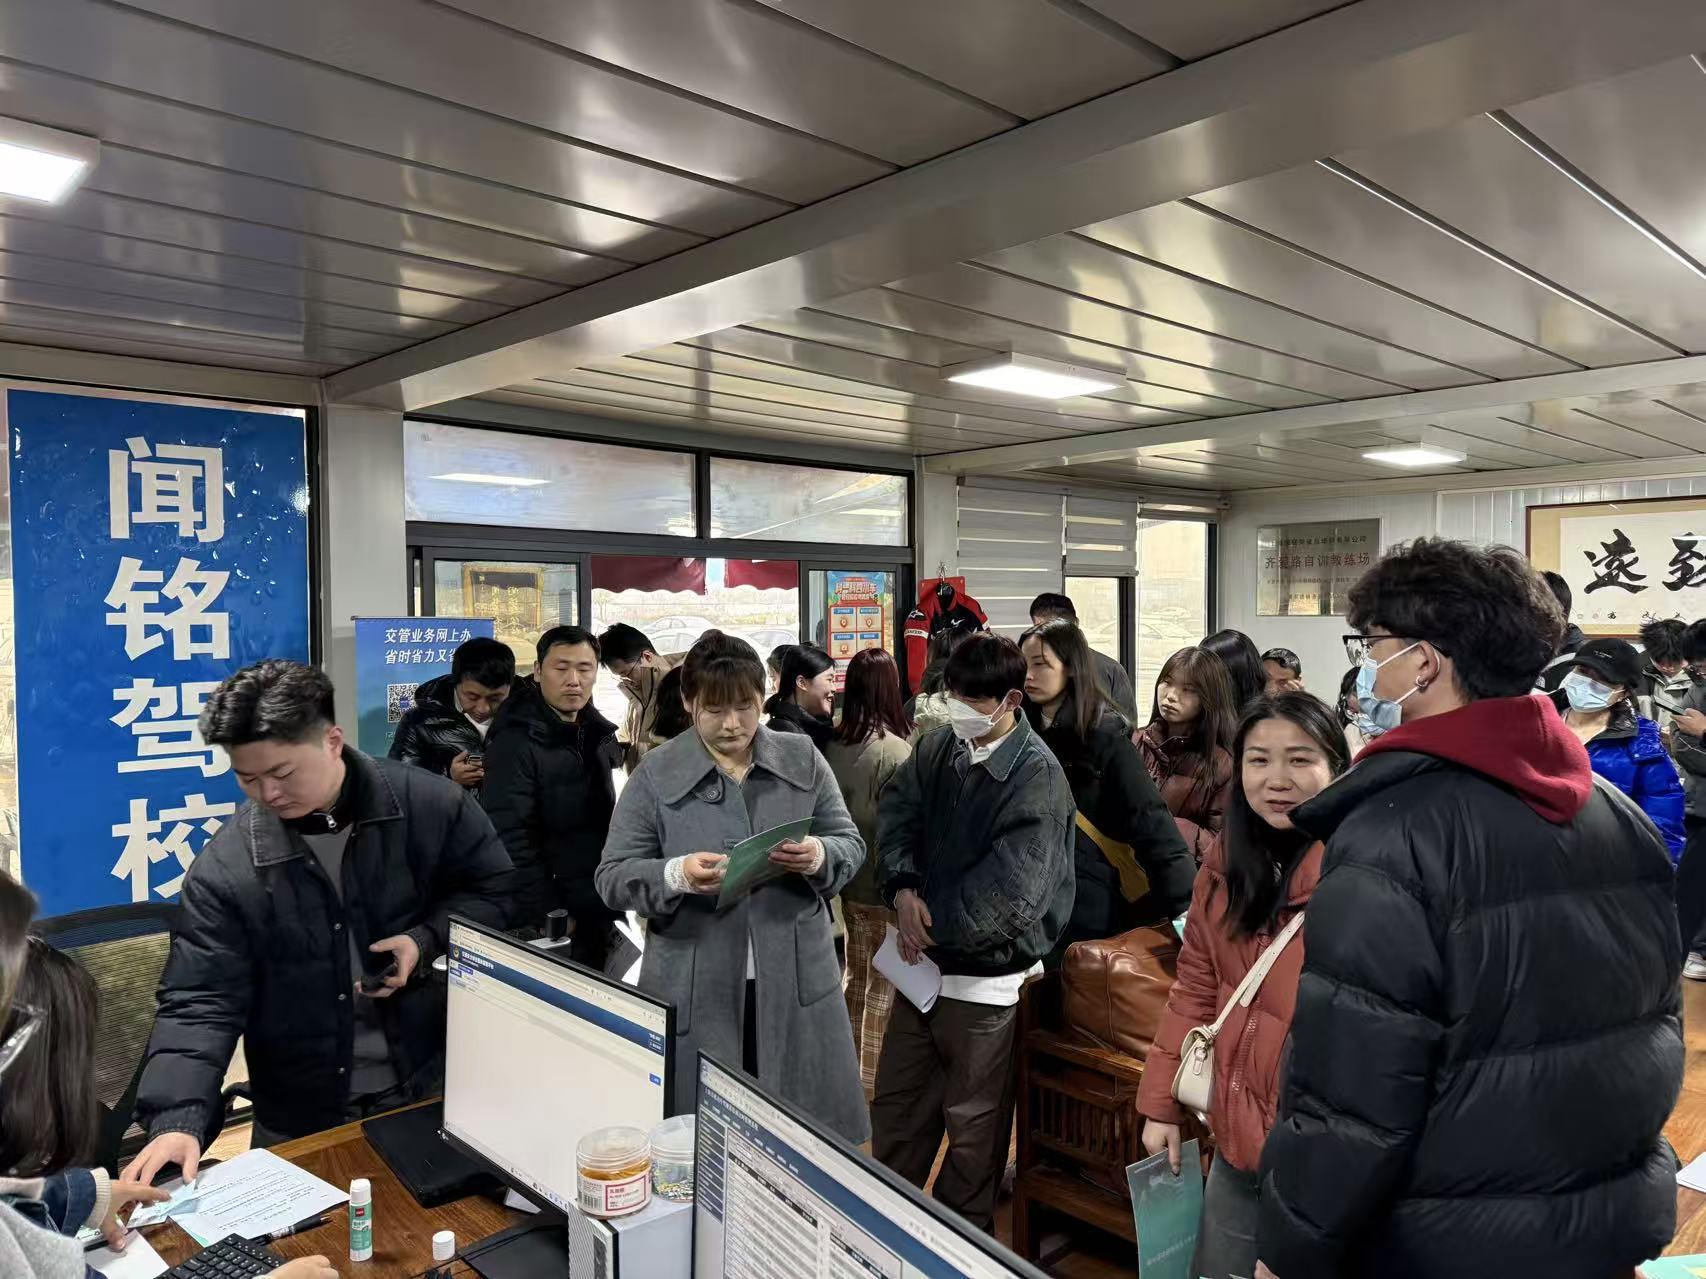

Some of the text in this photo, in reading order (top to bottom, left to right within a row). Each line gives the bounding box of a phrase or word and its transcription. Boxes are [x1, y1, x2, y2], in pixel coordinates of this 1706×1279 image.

[104, 436, 235, 903] 闻铭驾校
[385, 628, 471, 643] 交管业务网上办
